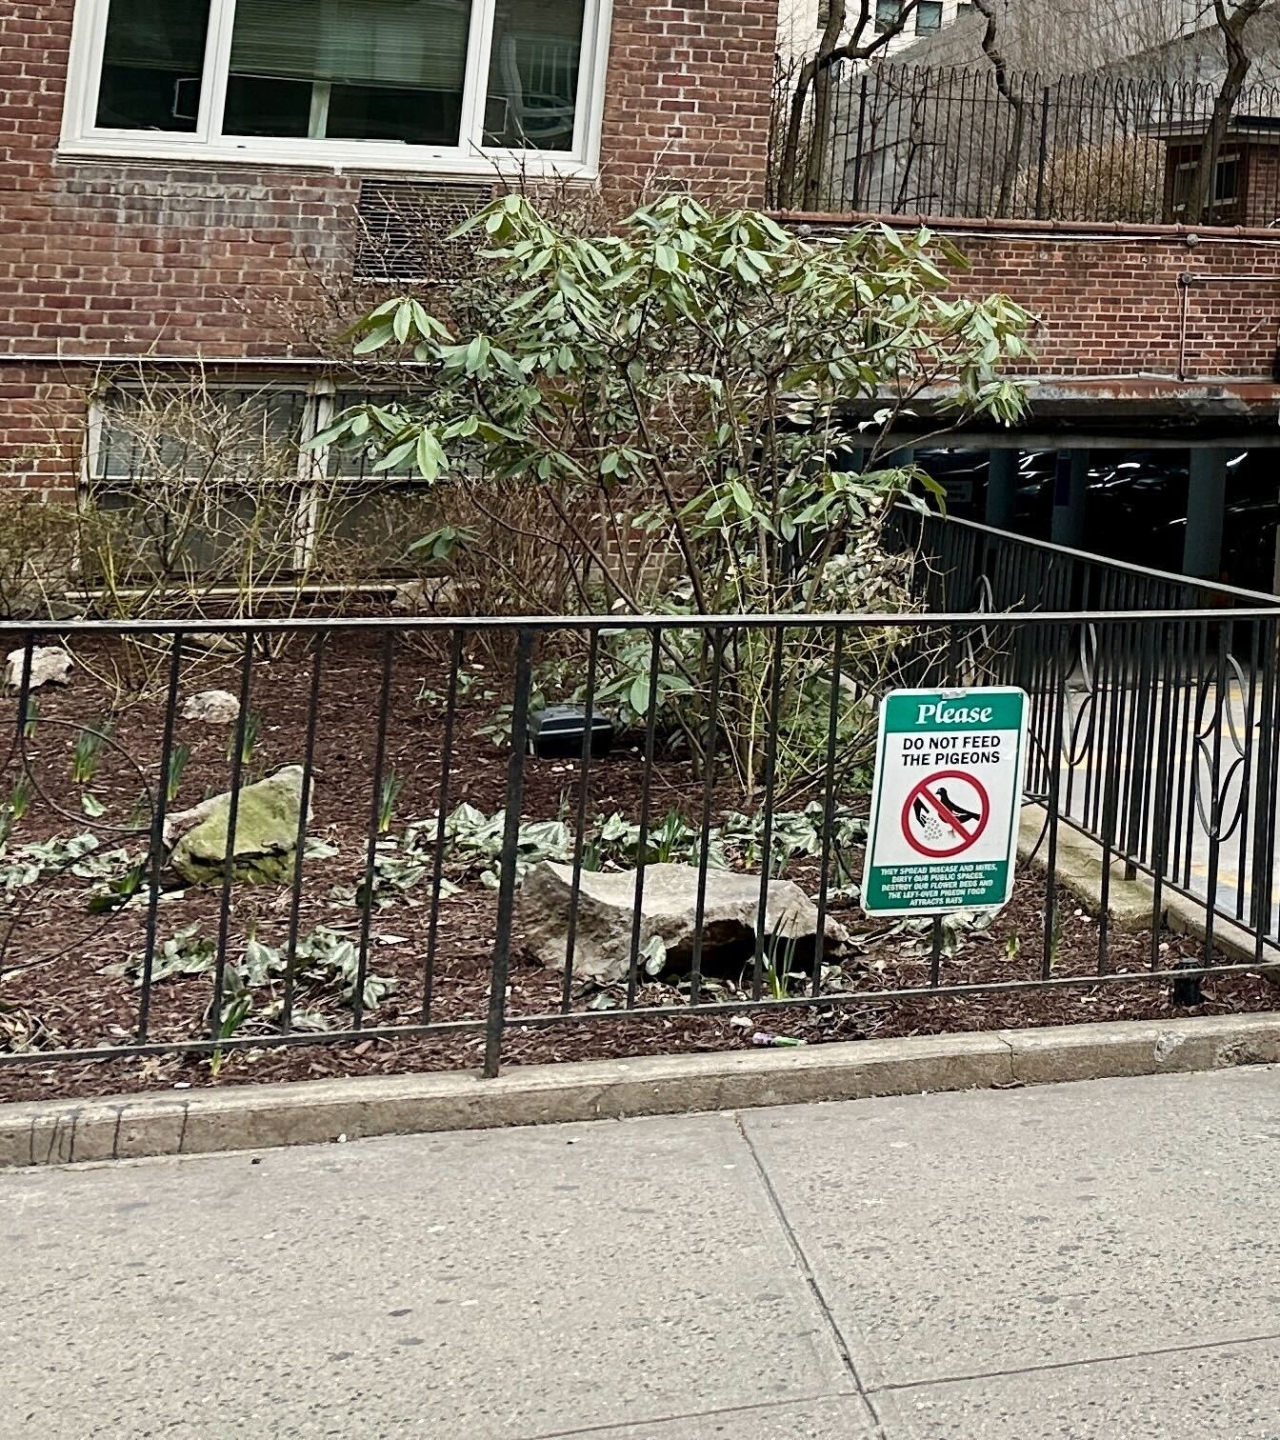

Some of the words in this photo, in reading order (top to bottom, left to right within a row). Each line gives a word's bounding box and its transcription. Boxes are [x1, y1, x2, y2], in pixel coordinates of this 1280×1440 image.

[915, 700, 993, 725] Please
[903, 737, 924, 750] DO
[929, 736, 958, 749] NOT
[963, 735, 1000, 748] FEED
[902, 753, 930, 766] THE
[935, 751, 1000, 765] PIGEONS
[929, 865, 958, 873] DISEASE
[892, 875, 912, 883] DIRTY
[914, 874, 929, 882] OUR
[930, 873, 956, 881] PUBLIC
[881, 883, 913, 892] DESTROY
[914, 882, 929, 890] OUR
[930, 881, 958, 889] FLOWER
[960, 880, 977, 888] BEDS
[979, 879, 993, 887] AND
[903, 890, 939, 898] LEFT-OVER
[940, 888, 965, 896] PIGEON
[967, 887, 986, 895] FOOD
[909, 898, 944, 906] ATTRACTS
